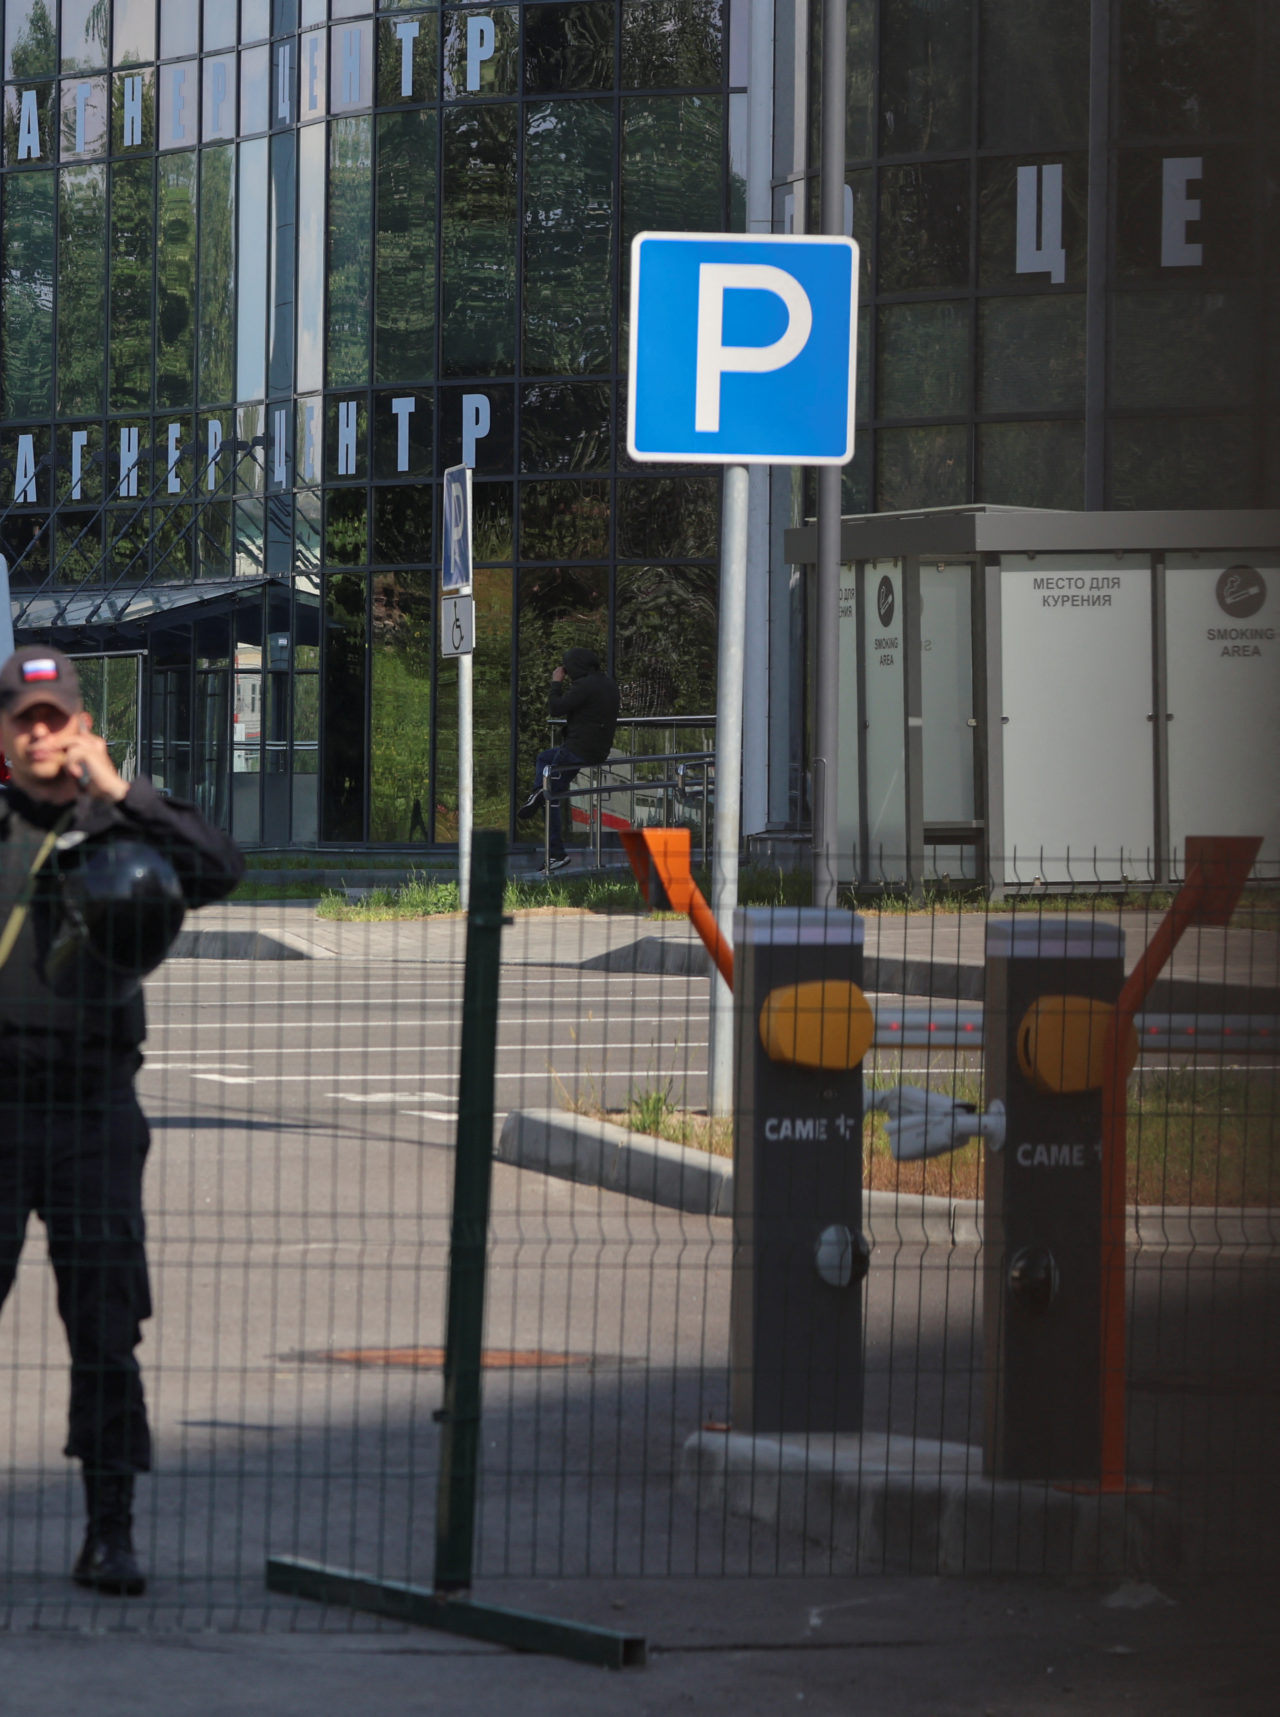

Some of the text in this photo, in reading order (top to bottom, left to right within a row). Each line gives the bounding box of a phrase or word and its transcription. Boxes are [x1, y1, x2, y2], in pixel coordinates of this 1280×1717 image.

[278, 16, 495, 124] ЦЕНТР
[695, 262, 812, 433] P
[274, 393, 490, 490] ЦЕНТР
[1033, 577, 1121, 591] МЕСТО ДЛЯ
[1042, 595, 1112, 607] КУРЕНИЯ
[1207, 628, 1275, 641] SMOKING
[1220, 645, 1262, 657] AREA
[880, 655, 894, 667] AREA
[765, 1118, 828, 1140] CAME
[1017, 1143, 1084, 1166] CAME
